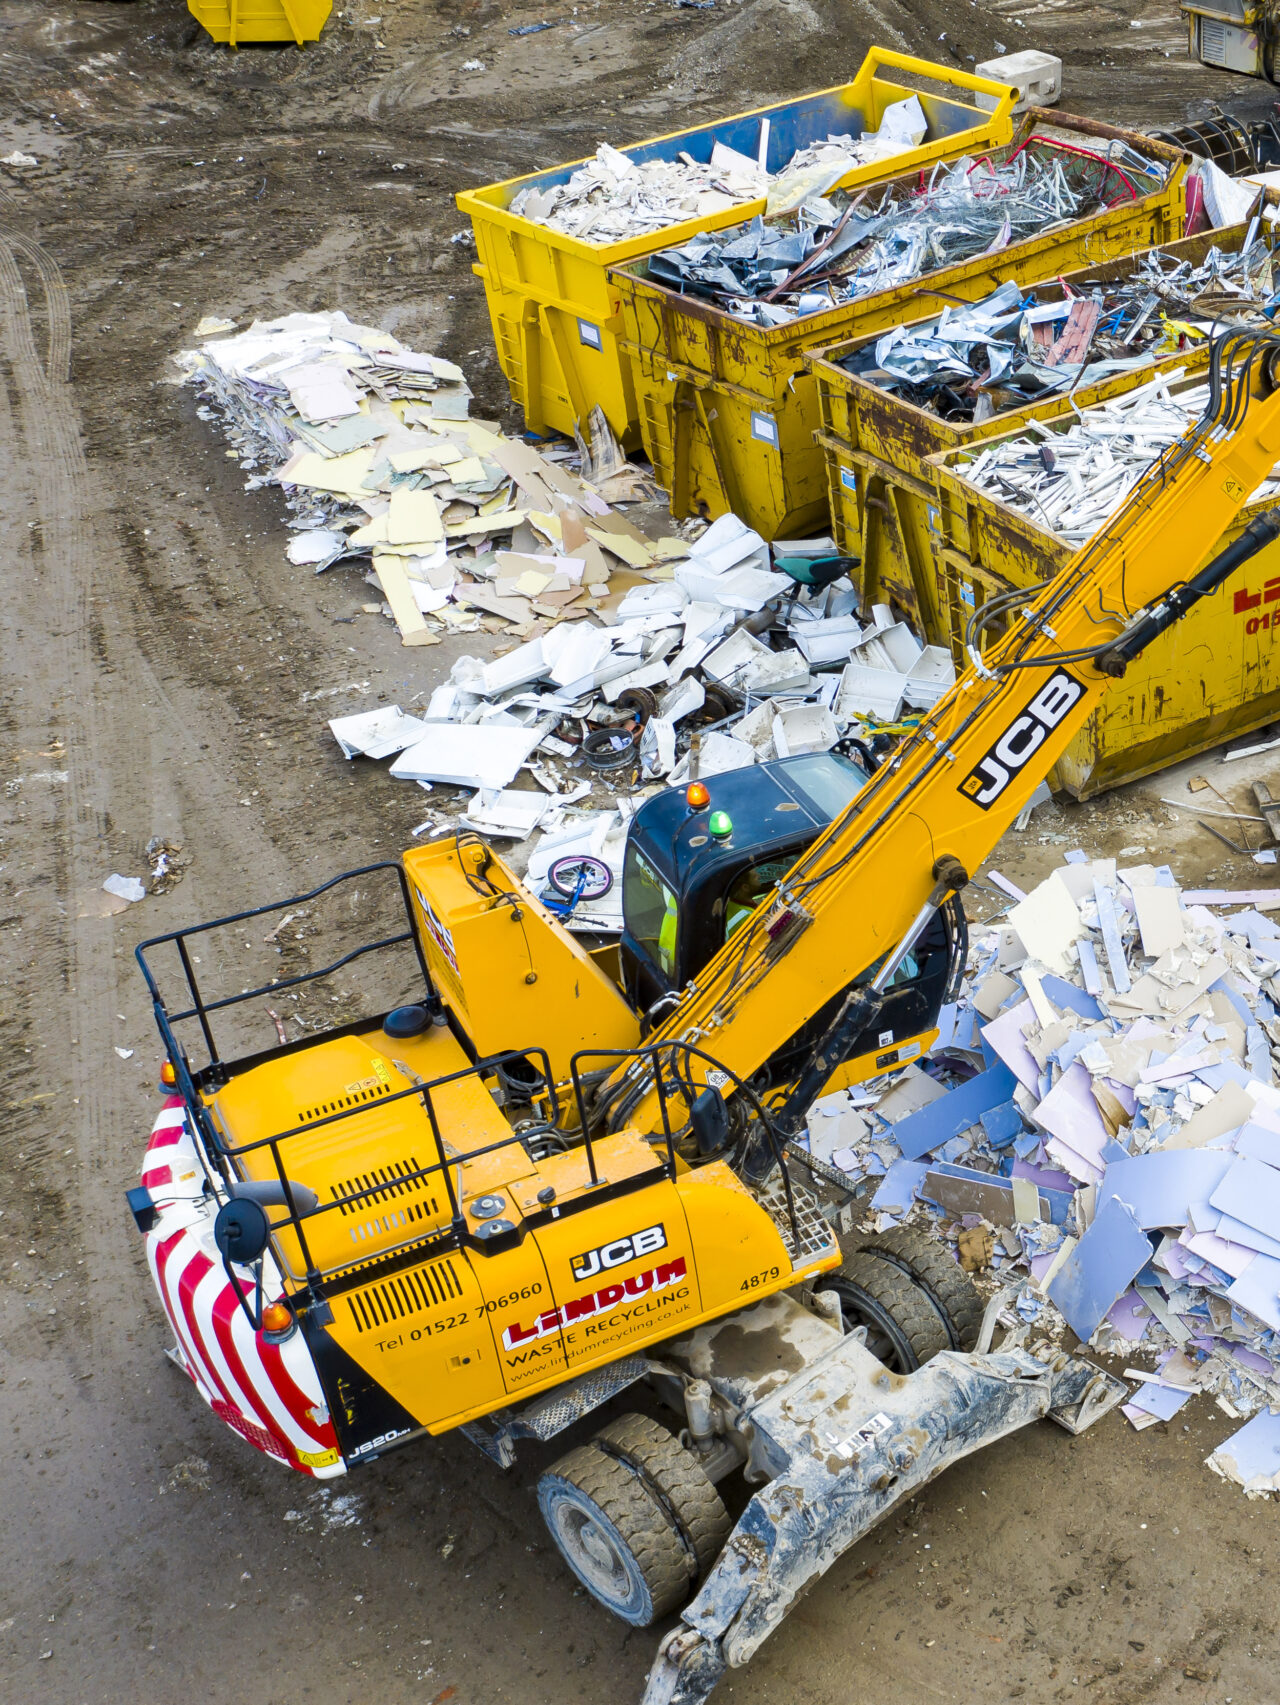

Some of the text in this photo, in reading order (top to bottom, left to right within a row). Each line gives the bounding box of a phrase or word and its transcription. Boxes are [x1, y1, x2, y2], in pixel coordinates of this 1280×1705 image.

[976, 674, 1081, 803] JCB
[575, 1226, 666, 1279] JCB
[739, 1266, 781, 1292] 4879
[374, 1282, 543, 1353] Tel 01522 706960
[502, 1256, 688, 1352] LINDUM
[506, 1287, 690, 1368] WASTE RECYCLING
[510, 1303, 692, 1383] www.lindumrecycling.co.uk
